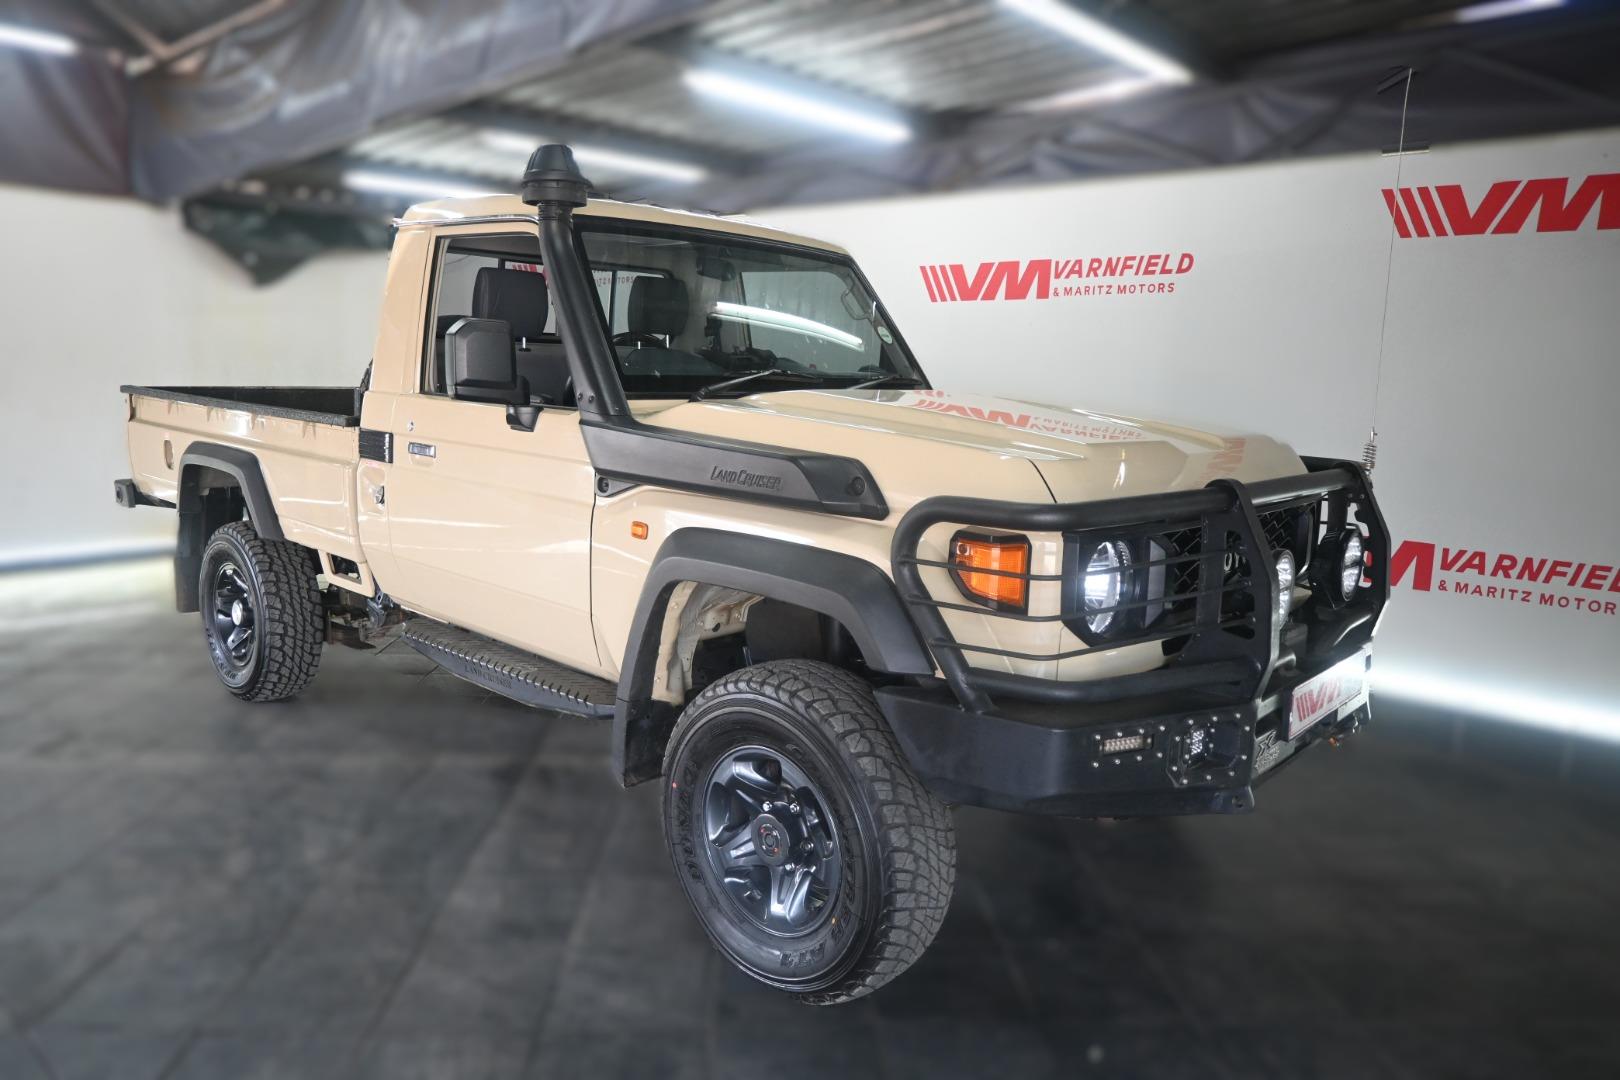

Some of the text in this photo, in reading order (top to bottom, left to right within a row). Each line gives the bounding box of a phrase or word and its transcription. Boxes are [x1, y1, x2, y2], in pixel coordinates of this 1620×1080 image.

[949, 259, 1052, 301] VM
[1053, 253, 1194, 280] VARNFIELD
[1052, 282, 1175, 297] & MARITZ MOTORS
[1440, 547, 1620, 593] VARNFIEL
[1438, 580, 1617, 615] & MARITZ MOTOR
